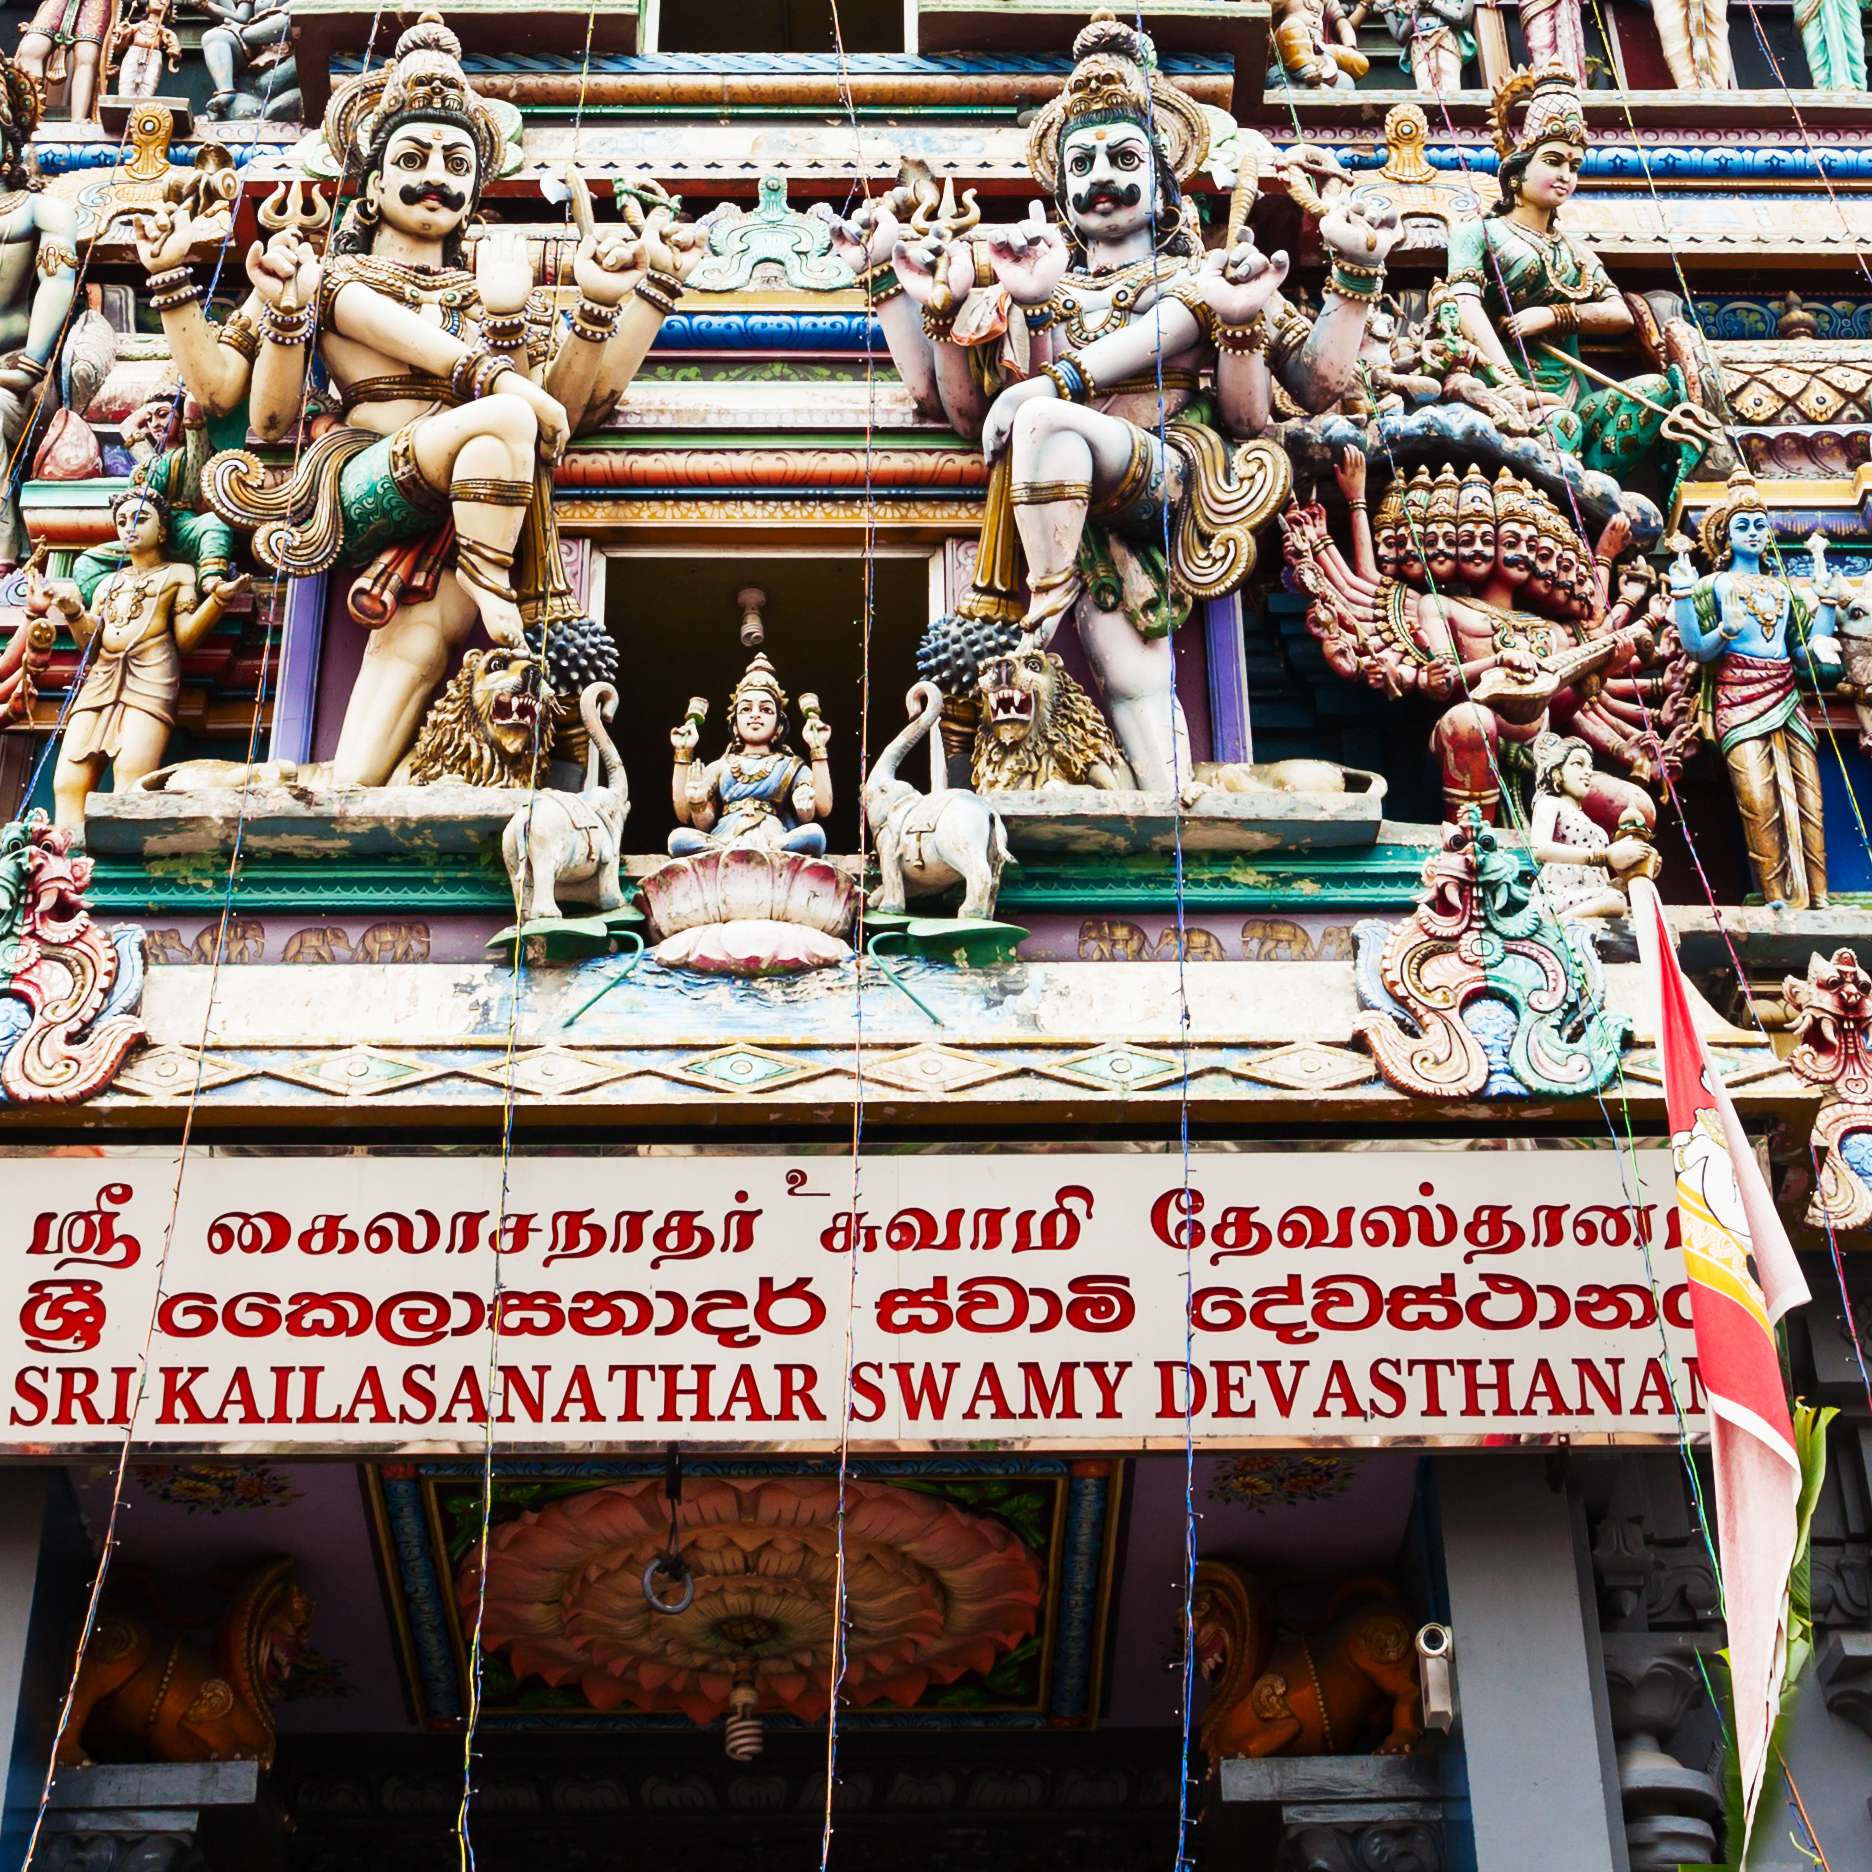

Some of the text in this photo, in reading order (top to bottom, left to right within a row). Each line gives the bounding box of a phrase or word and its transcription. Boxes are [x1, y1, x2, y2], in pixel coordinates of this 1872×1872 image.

[207, 1190, 763, 1269] கைலாசநாதர்
[1150, 1182, 1682, 1266] தேவஸ்தான
[874, 1275, 1135, 1334] ස්වාමි
[9, 1365, 136, 1426] SRI
[155, 1364, 827, 1425] KAILASANATHAR
[849, 1361, 1132, 1422] SWAMY
